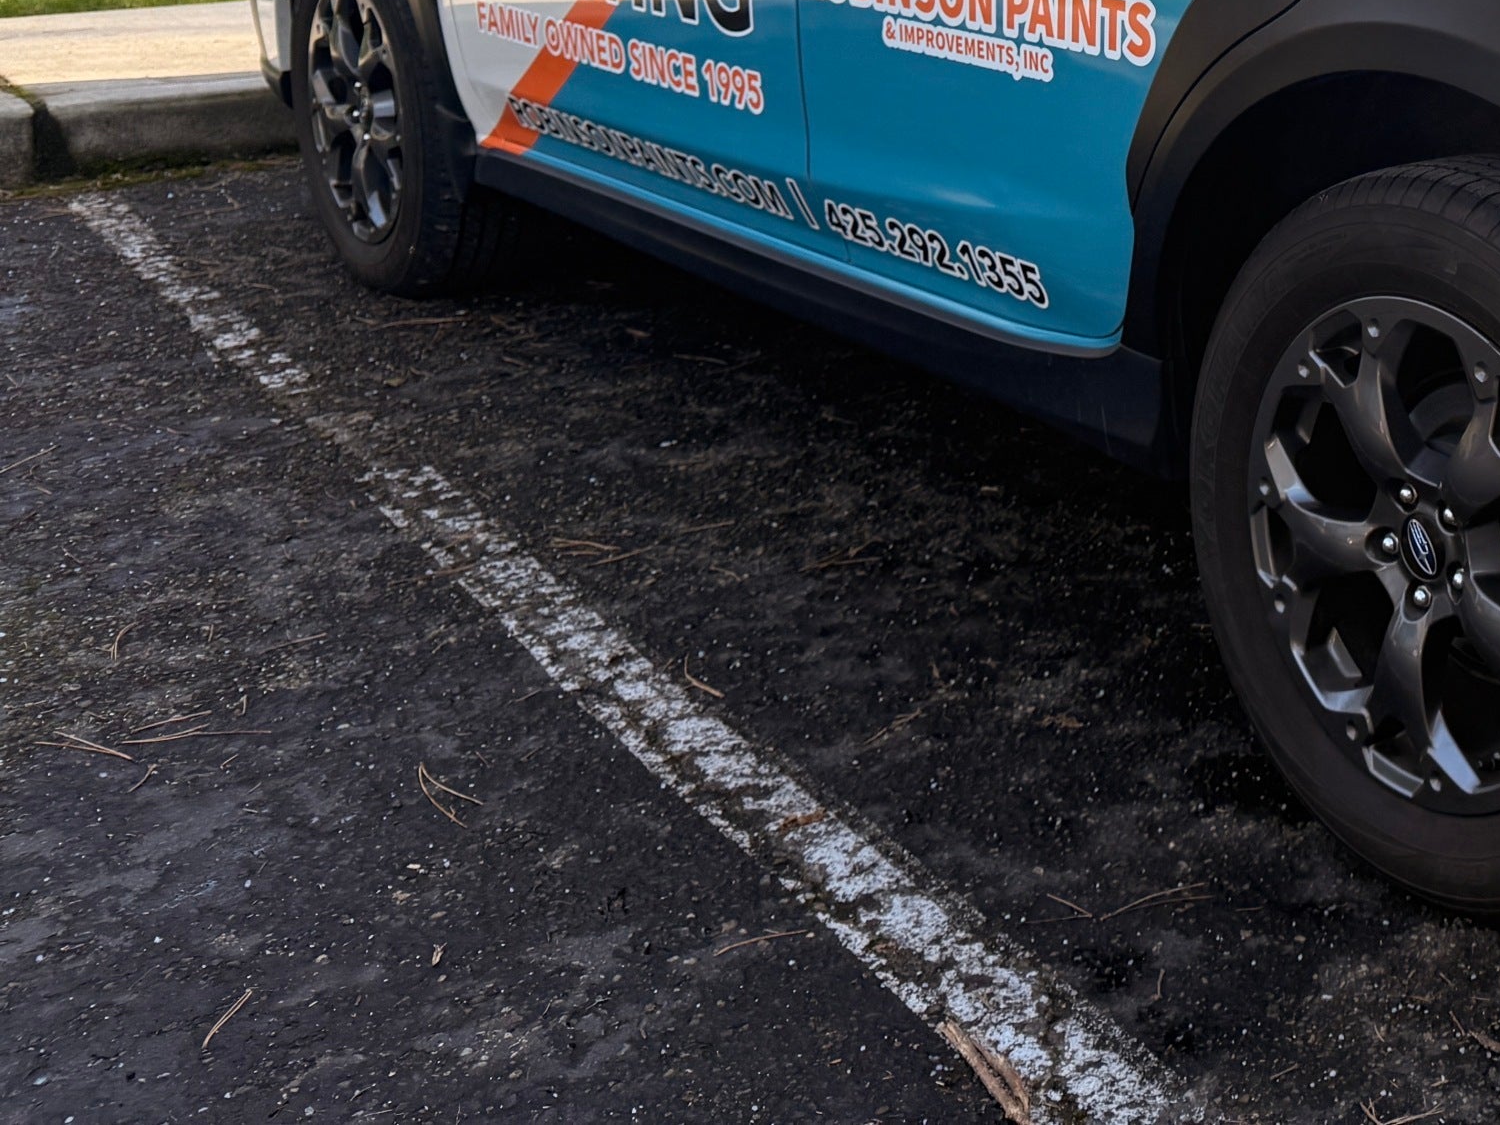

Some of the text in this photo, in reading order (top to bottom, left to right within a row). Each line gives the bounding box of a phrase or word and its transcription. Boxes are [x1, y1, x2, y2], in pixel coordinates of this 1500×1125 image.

[476, 1, 763, 112] FAMILY OWNED SINCE 1995
[885, 19, 1049, 74] & IMPROVEMENTS, INC
[825, 199, 1048, 308] 425.292.1355
